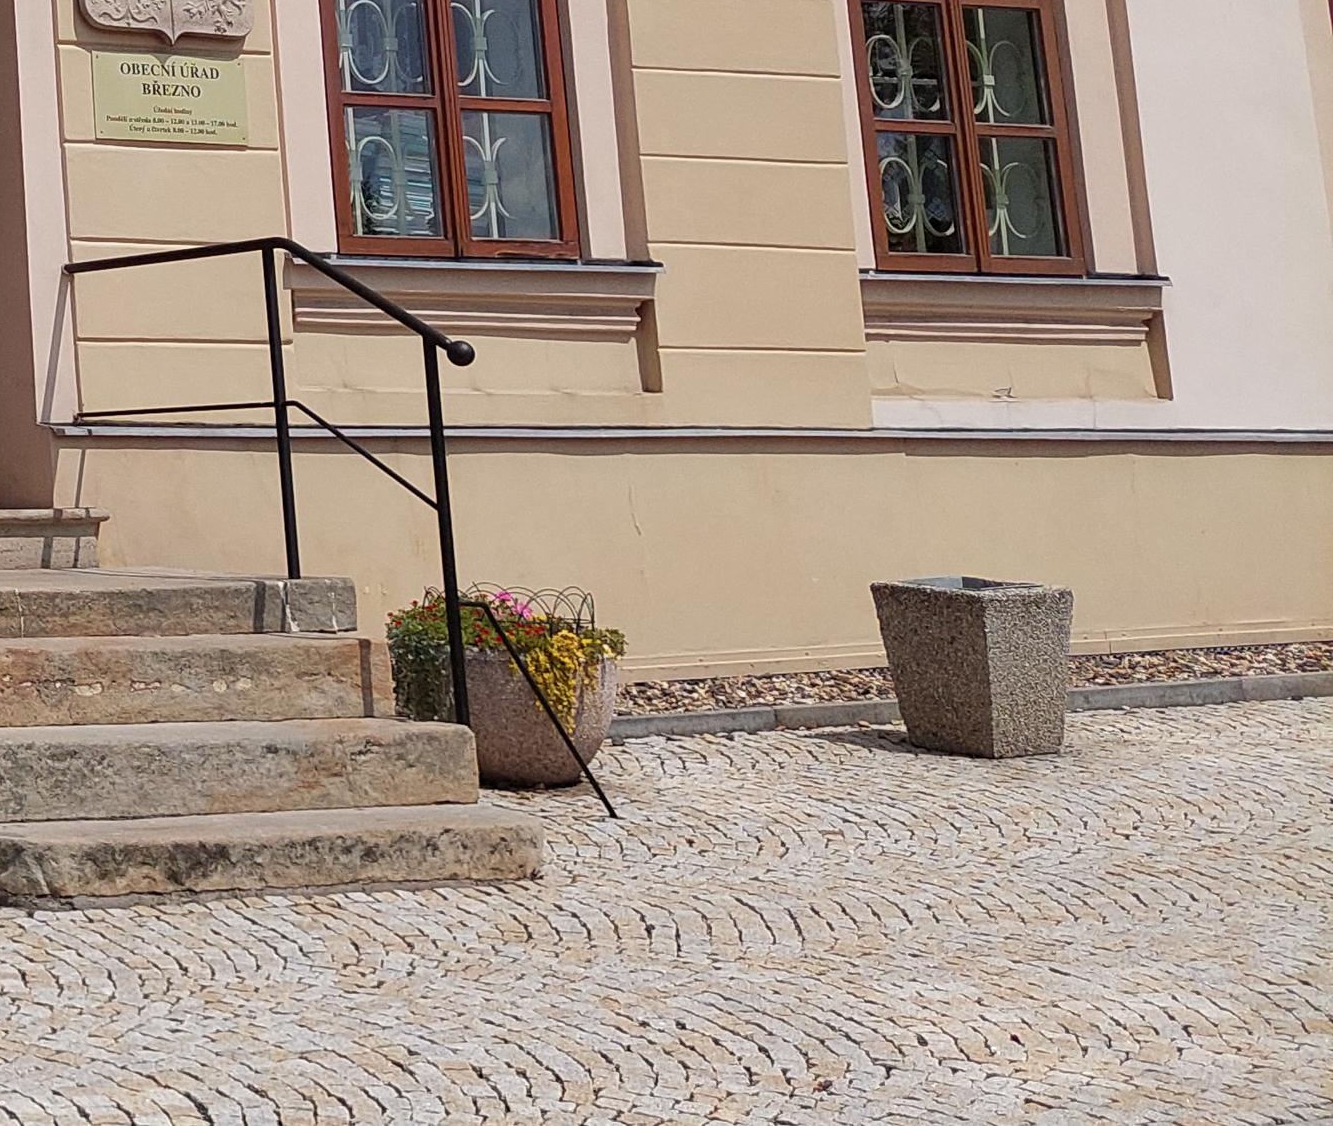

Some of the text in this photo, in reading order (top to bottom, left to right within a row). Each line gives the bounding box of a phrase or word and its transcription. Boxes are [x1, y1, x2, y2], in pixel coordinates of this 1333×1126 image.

[120, 62, 220, 79] OBECNÍ ÚŘAD
[142, 81, 201, 98] BŘEZNO
